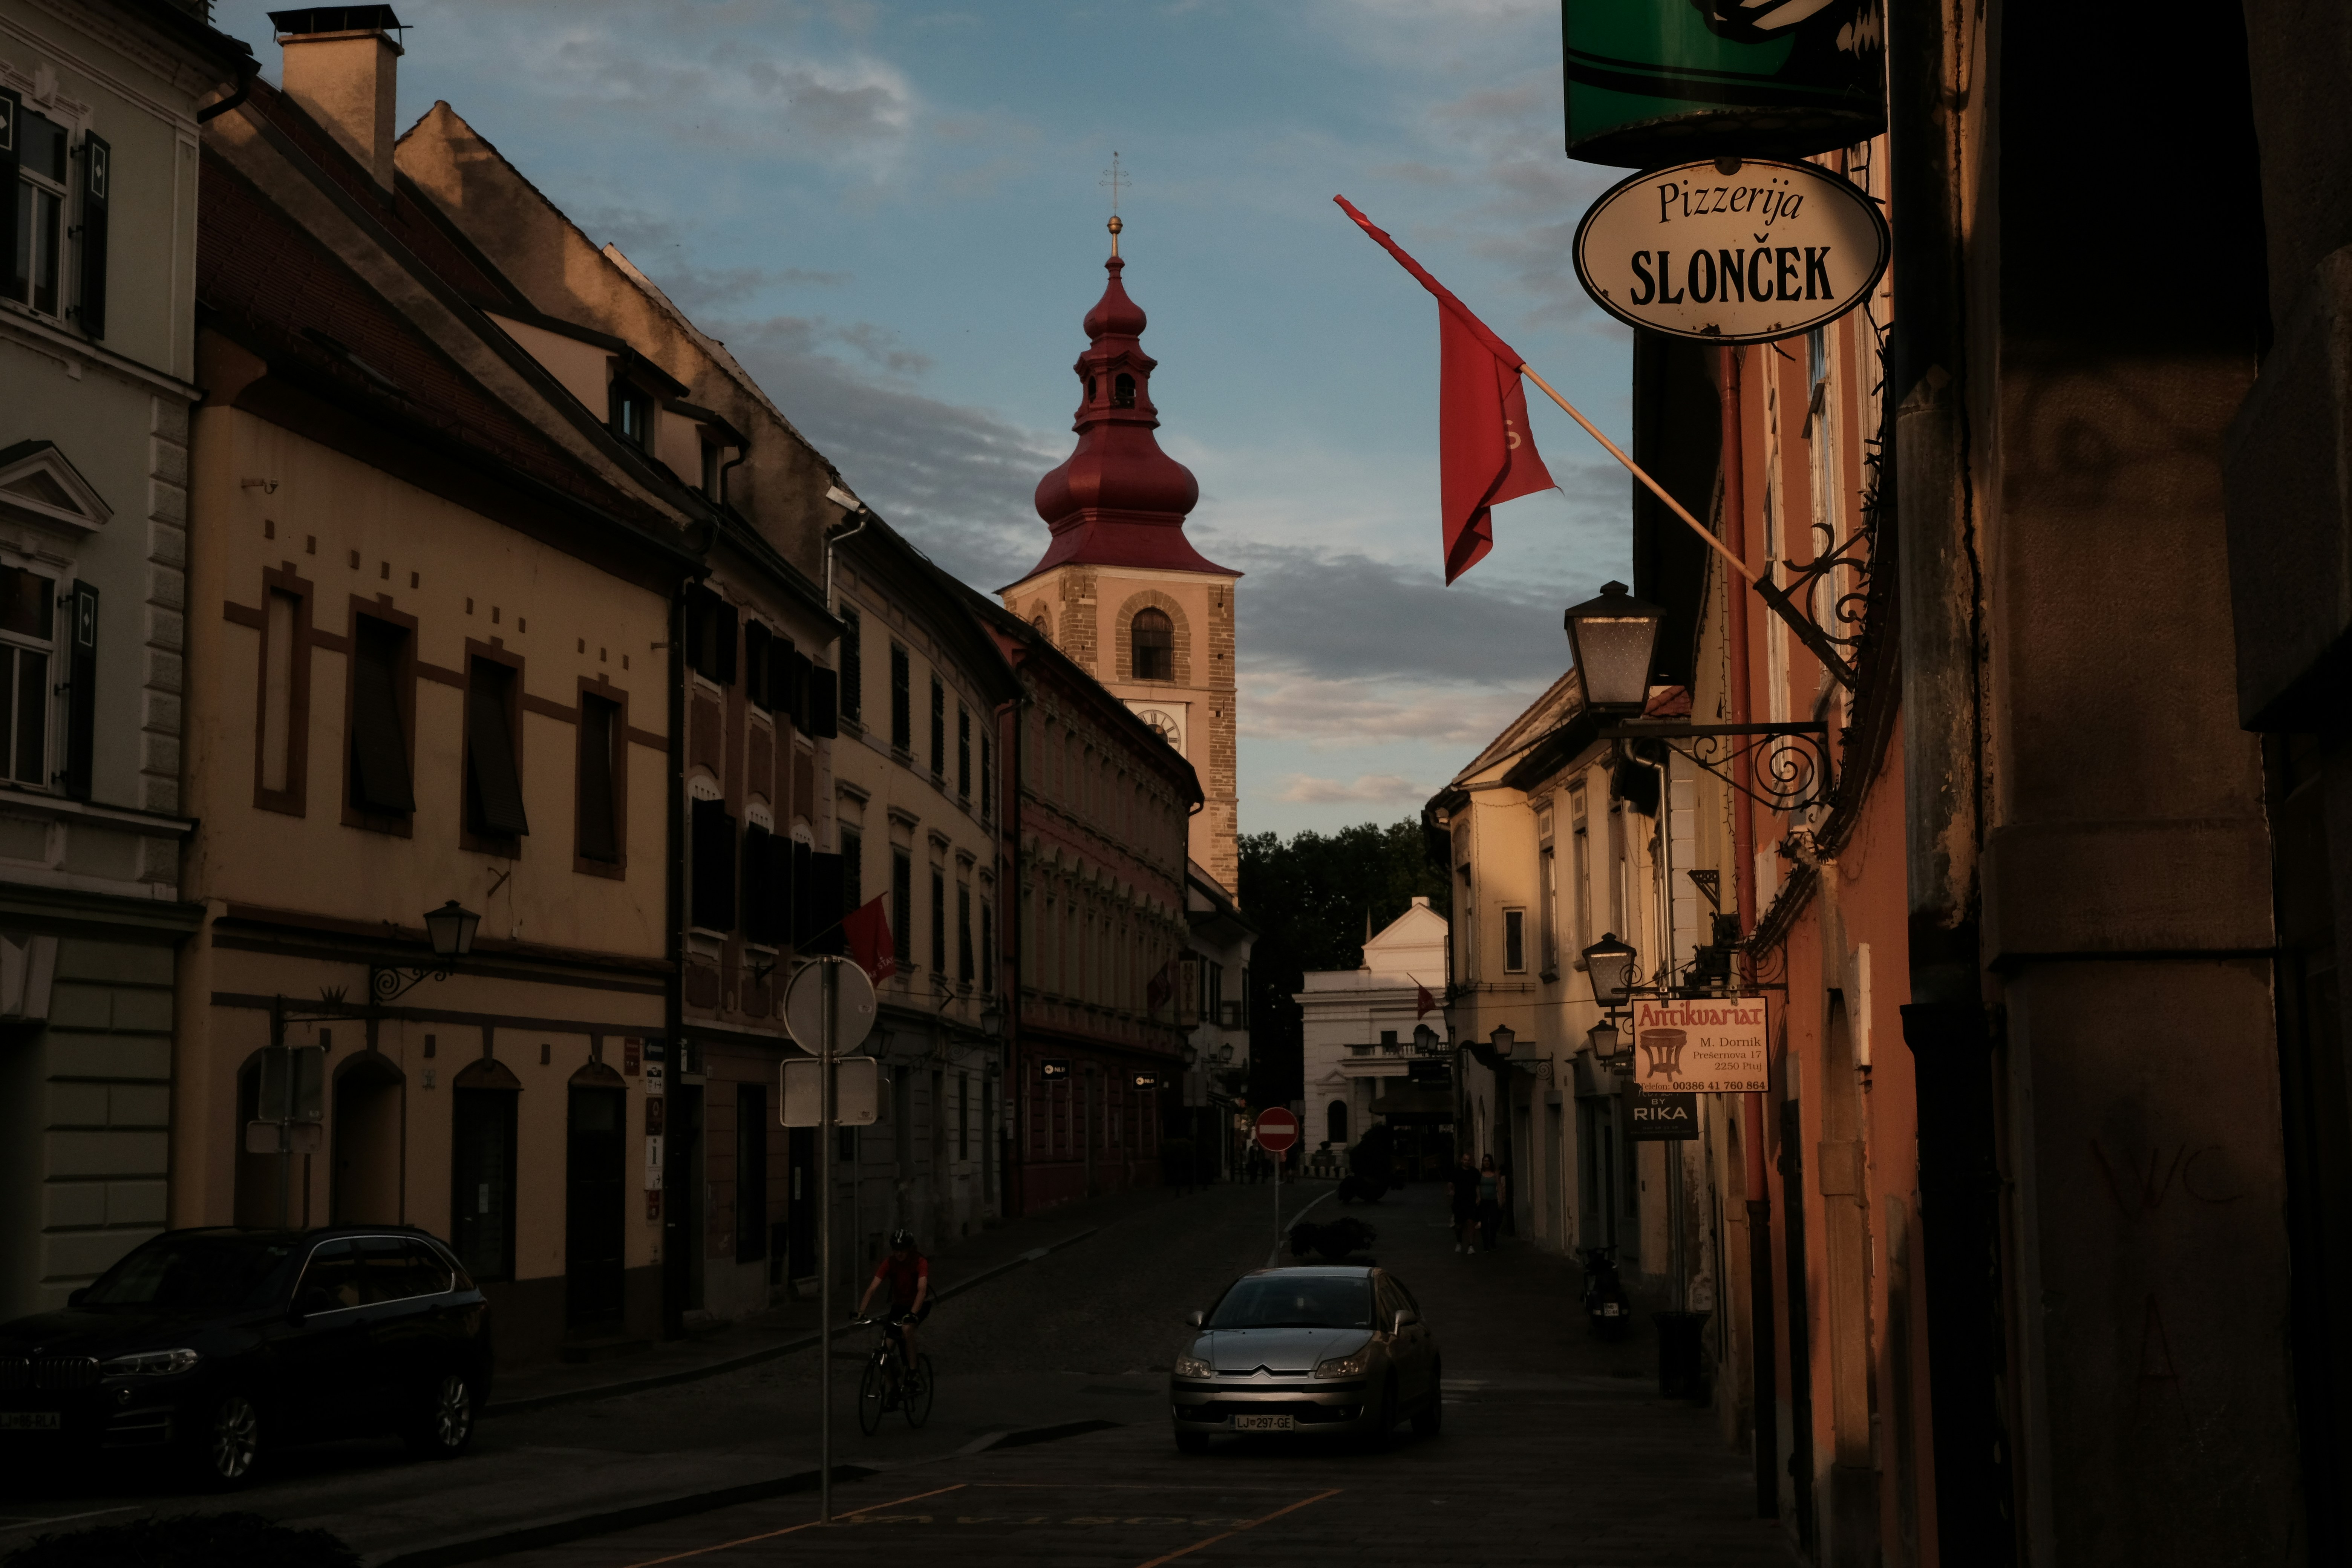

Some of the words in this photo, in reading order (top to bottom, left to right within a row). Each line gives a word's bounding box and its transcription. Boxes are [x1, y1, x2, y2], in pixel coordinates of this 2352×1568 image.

[1657, 178, 1804, 225] Pizzerija
[1630, 233, 1834, 306] SLONČEK
[1700, 1037, 1714, 1047] M.
[1720, 1037, 1761, 1047] Dornik
[1693, 1051, 1746, 1059] Prešernova
[1743, 1062, 1762, 1072] Ptuj
[1672, 1081, 1704, 1090] 00386
[1708, 1081, 1720, 1090] 41
[1724, 1081, 1743, 1090] 760
[1746, 1081, 1765, 1090] 864
[1634, 1107, 1688, 1121] RIKA
[1237, 1418, 1249, 1428] LJ
[1257, 1418, 1291, 1428] 297-GE
